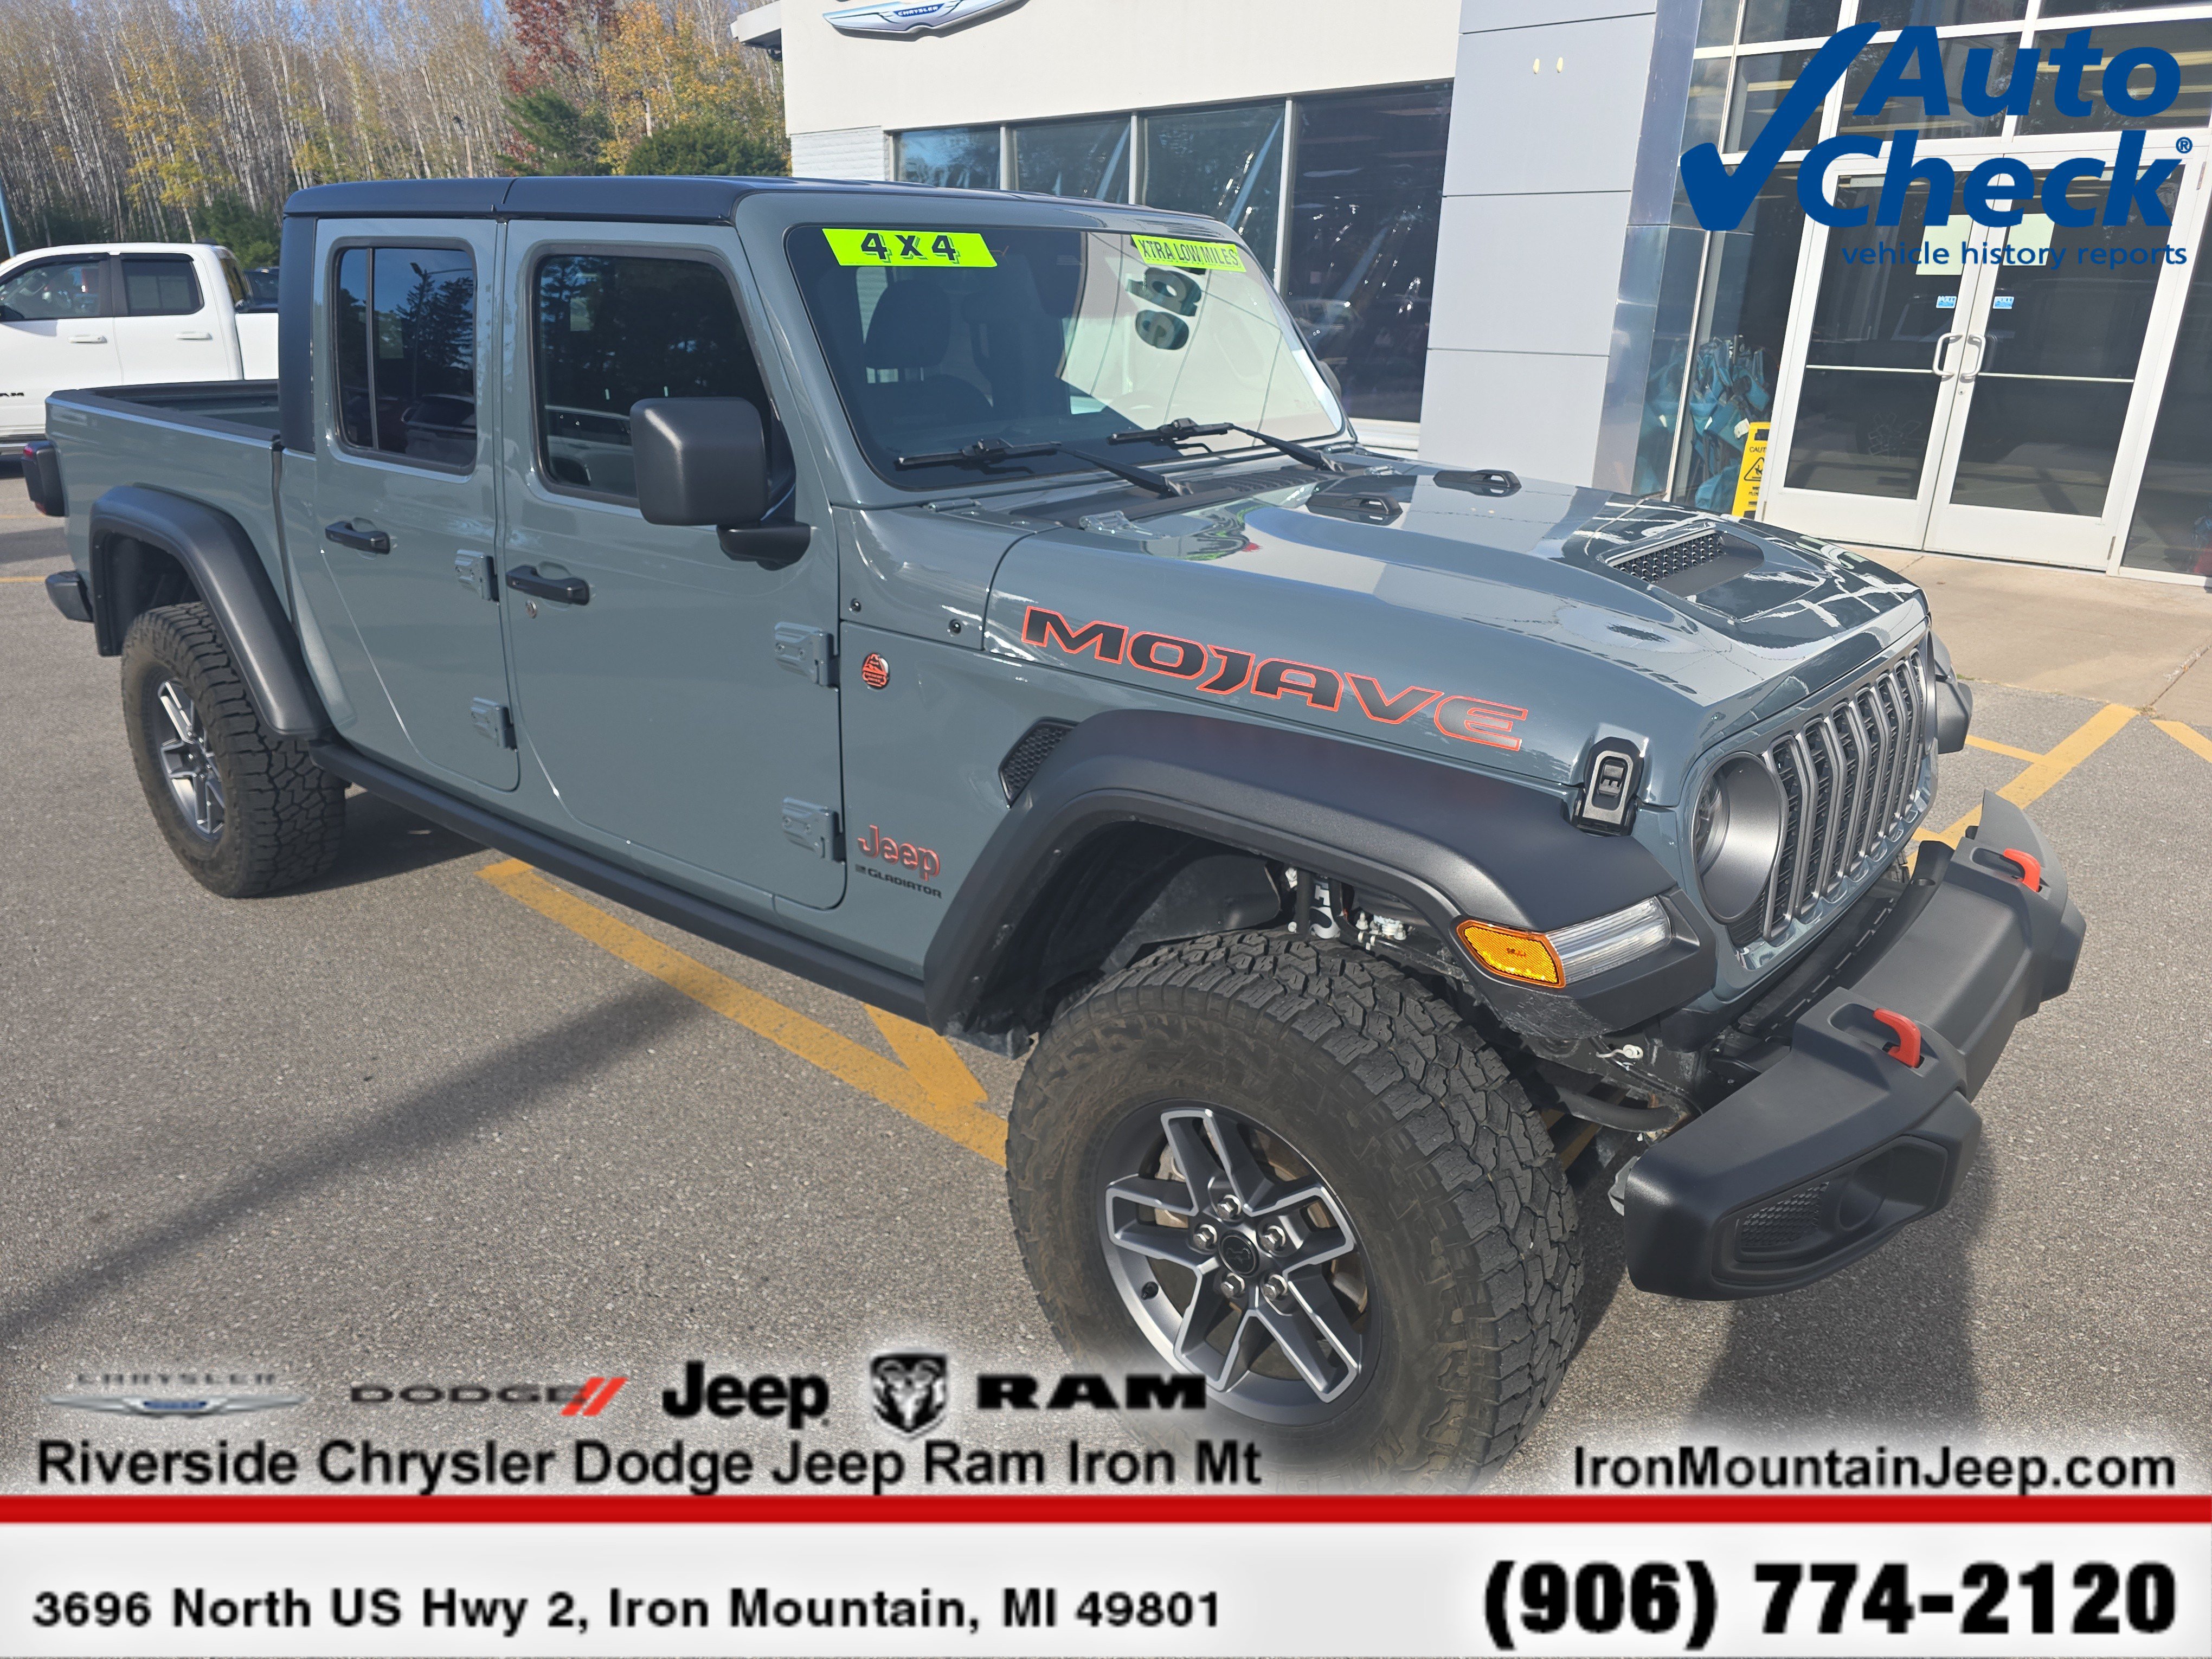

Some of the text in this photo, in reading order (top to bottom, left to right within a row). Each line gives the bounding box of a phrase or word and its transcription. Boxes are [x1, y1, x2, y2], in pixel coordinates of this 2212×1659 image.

[897, 5, 939, 16] CHRYSLER
[1138, 239, 1175, 260] XTRA
[1173, 243, 1202, 262] LOW
[1199, 246, 1241, 266] MILES
[1021, 606, 1528, 751] MOJAVE
[857, 824, 941, 882] Jeep
[867, 867, 943, 898] GLADIATOR
